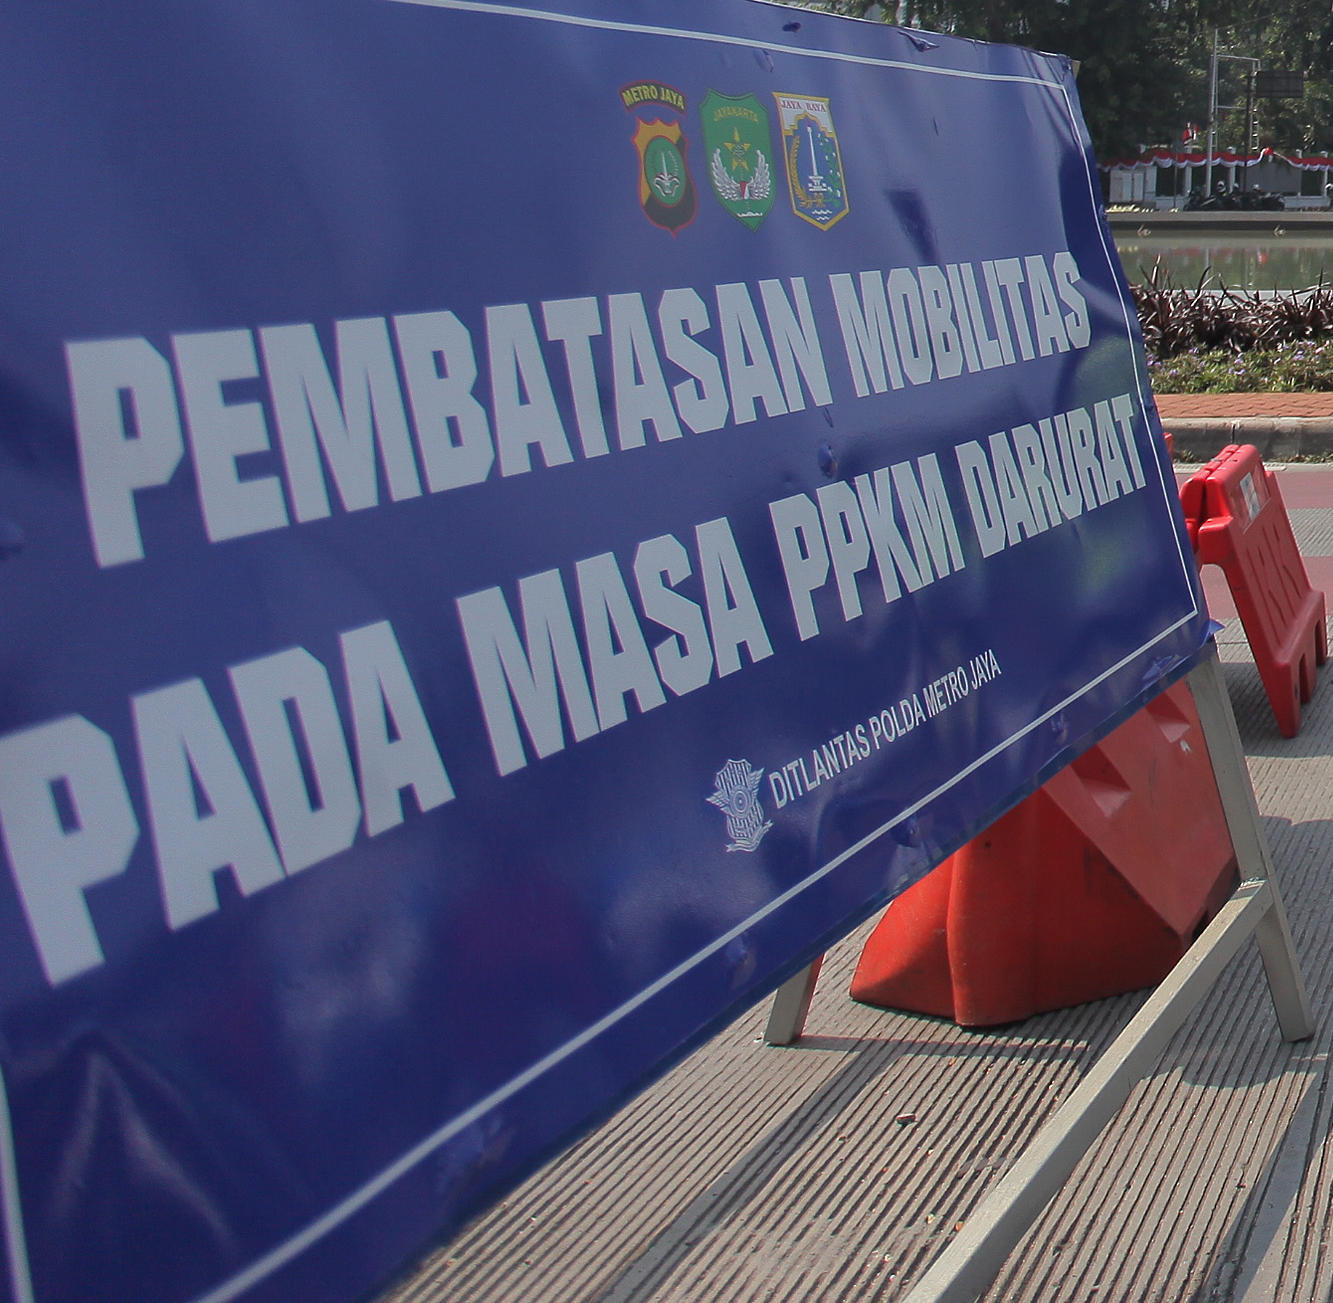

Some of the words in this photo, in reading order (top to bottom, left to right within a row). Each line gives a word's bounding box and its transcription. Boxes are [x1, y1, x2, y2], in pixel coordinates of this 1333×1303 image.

[621, 84, 659, 107] METRO
[660, 89, 685, 110] JAYA
[713, 107, 759, 123] JAYAKARTA
[781, 100, 802, 110] JAYA
[67, 277, 834, 566] PEMBATASAN
[829, 251, 1091, 397] MOBILITAS
[0, 620, 455, 986] PADA
[456, 517, 773, 777] MASA
[768, 453, 966, 642] PPKM
[955, 393, 1147, 559] DARURAT
[769, 724, 872, 809] DITLANTAS
[869, 693, 927, 749] POLDA
[922, 666, 969, 718] METRO
[969, 649, 1002, 690] JAYA
